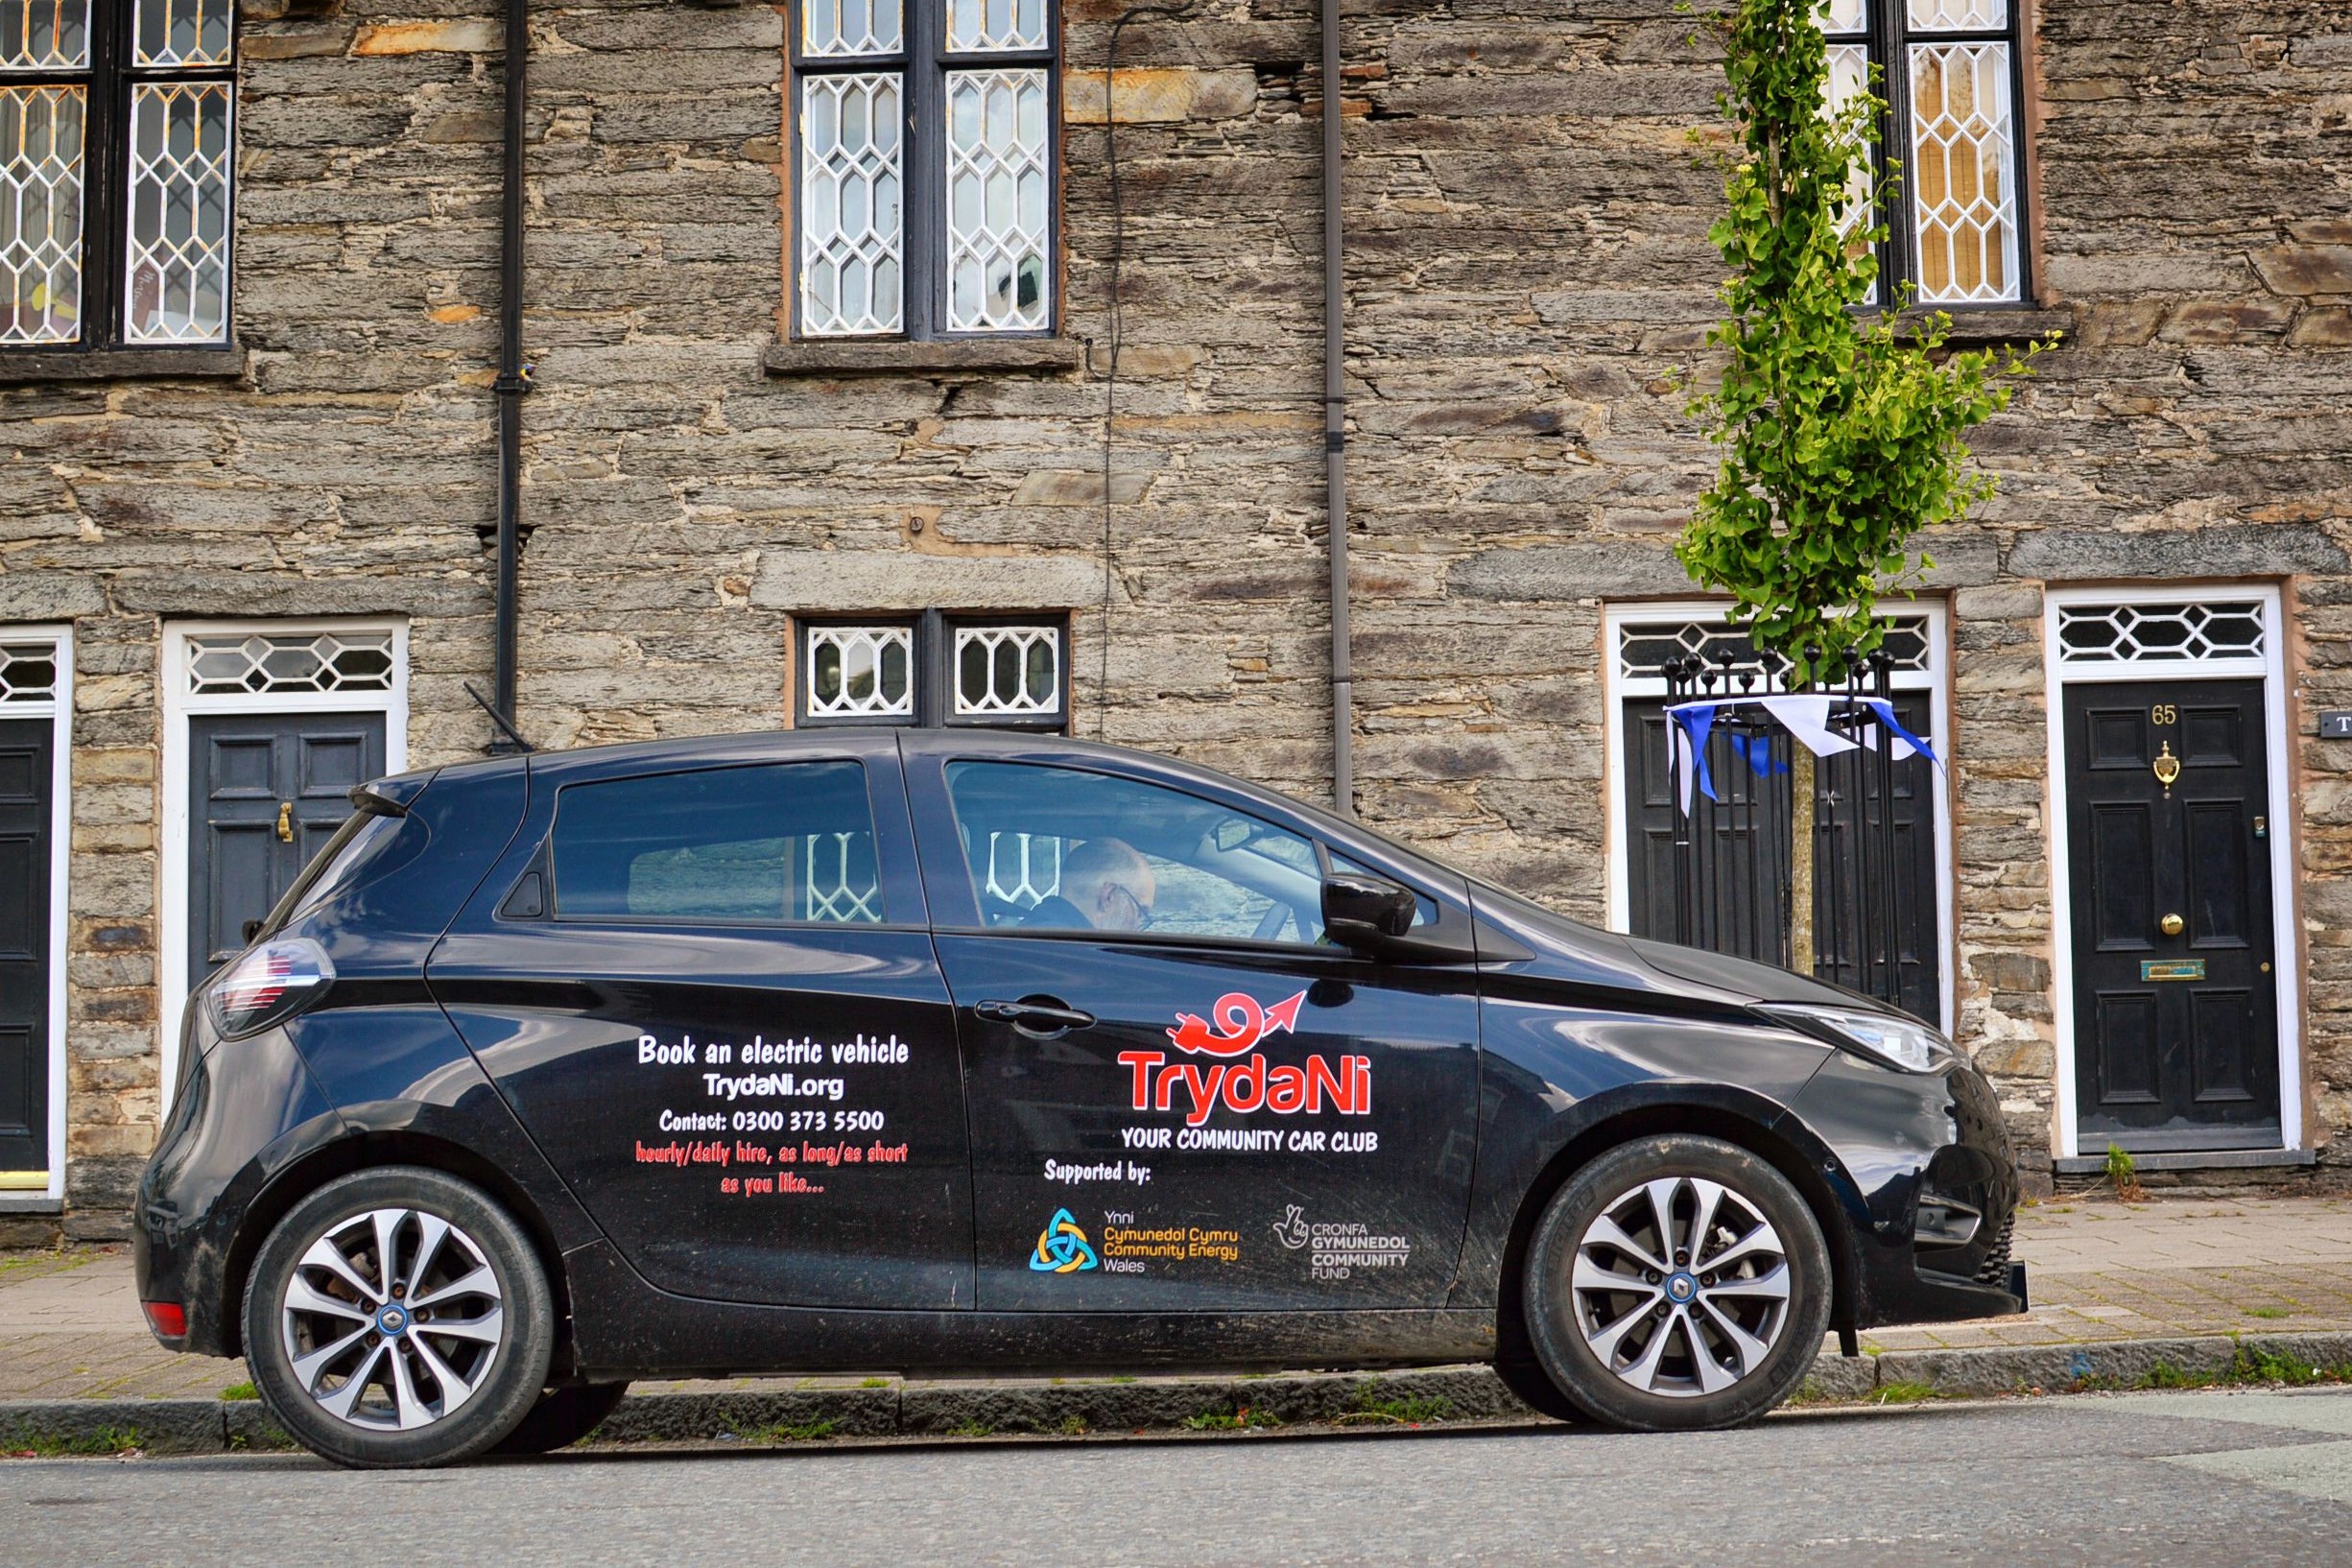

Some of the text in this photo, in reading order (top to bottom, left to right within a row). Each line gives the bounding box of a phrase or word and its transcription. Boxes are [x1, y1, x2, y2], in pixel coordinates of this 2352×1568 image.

[2151, 704, 2176, 725] 65
[637, 1033, 909, 1064] Book an electric vehicle
[702, 1074, 843, 1101] TrydaNi.org
[1118, 1051, 1371, 1127] TrydaNi
[659, 1109, 884, 1131] Contact: 0300 373 5500
[1122, 1128, 1377, 1152] YOUR COMMUNITY CAR CLUB
[636, 1140, 908, 1167] hourly/daily hire, as long/as short
[1044, 1159, 1151, 1185] Supported by:
[721, 1172, 824, 1198] as you like...
[1105, 1211, 1133, 1224] Ynni
[1105, 1227, 1238, 1247] Cymunedol Cymru
[1312, 1224, 1367, 1236] CRONFA
[1104, 1242, 1238, 1260] Community Energy
[1312, 1236, 1410, 1248] GYMUNEDOL
[1104, 1258, 1145, 1272] Wales
[1312, 1254, 1409, 1268] COMMUNITY
[1312, 1267, 1350, 1279] FUND
